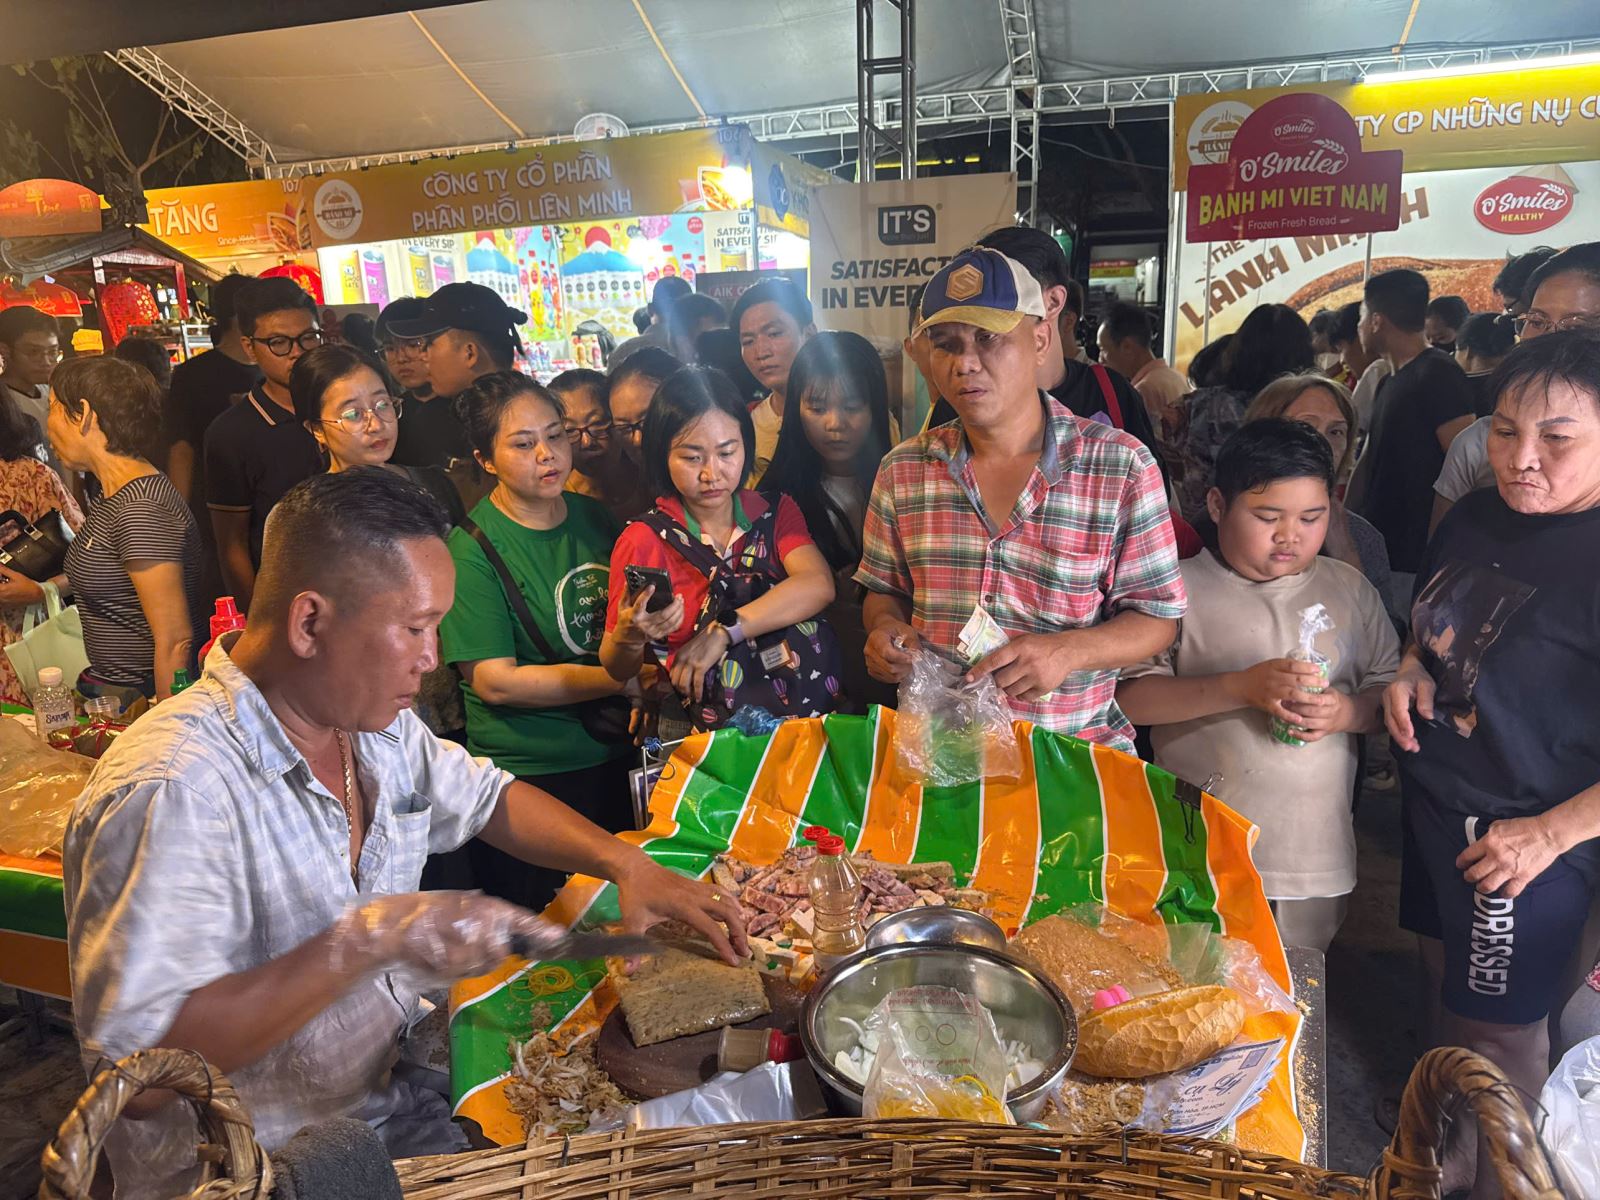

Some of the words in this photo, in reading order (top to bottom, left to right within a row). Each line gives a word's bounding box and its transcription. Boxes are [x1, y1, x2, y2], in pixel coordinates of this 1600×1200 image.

[1355, 113, 1385, 137] TY
[1393, 111, 1424, 134] CP
[1431, 96, 1523, 132] NHỮNG
[1532, 97, 1572, 126] NỤ
[422, 171, 478, 199] CÔNG
[483, 168, 508, 190] TY
[516, 152, 546, 188] CỔ
[1240, 149, 1349, 182] O'Smiles
[282, 180, 299, 193] 107
[150, 199, 218, 236] TĂNG
[412, 203, 466, 233] PHÂN
[472, 194, 522, 227] PHỐI
[528, 193, 572, 222] LIÊN
[577, 189, 633, 217] MINH
[1199, 190, 1256, 226] BANH
[1261, 188, 1284, 210] MI
[1290, 185, 1336, 207] VIET
[1340, 183, 1388, 215] NAM
[1481, 188, 1568, 217] O'Smiles
[1501, 212, 1544, 222] HEALTHY
[882, 209, 931, 234] IT'S
[1248, 219, 1278, 230] Frozen
[1281, 218, 1306, 228] Fresh
[1309, 216, 1337, 226] Bread
[413, 237, 439, 248] EVERY
[442, 239, 455, 249] SIP
[822, 287, 852, 309] IN
[1467, 891, 1514, 996] DRESSED
